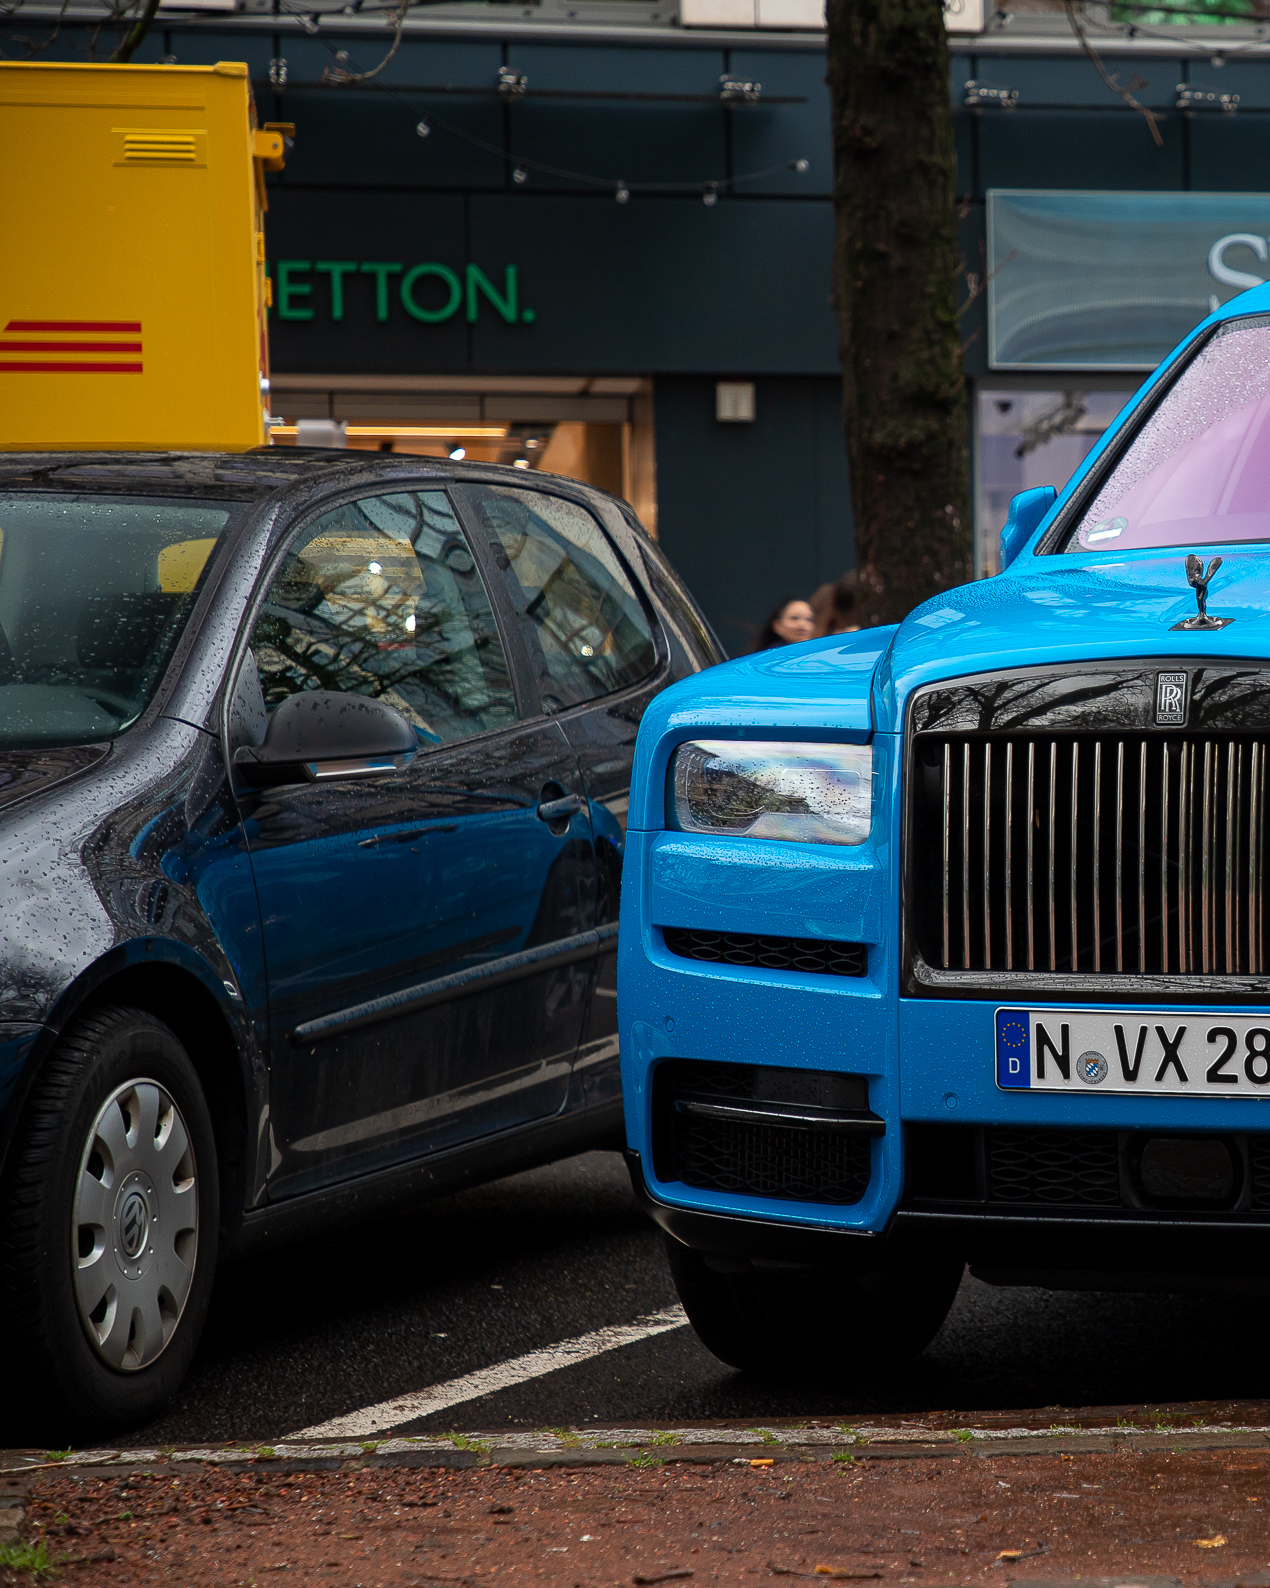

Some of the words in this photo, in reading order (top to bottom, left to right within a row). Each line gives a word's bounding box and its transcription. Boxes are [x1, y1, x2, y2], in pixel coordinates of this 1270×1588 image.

[1160, 684, 1182, 712] RR
[1008, 1057, 1020, 1075] D
[1035, 1022, 1071, 1080] N
[1113, 1024, 1190, 1083] VX
